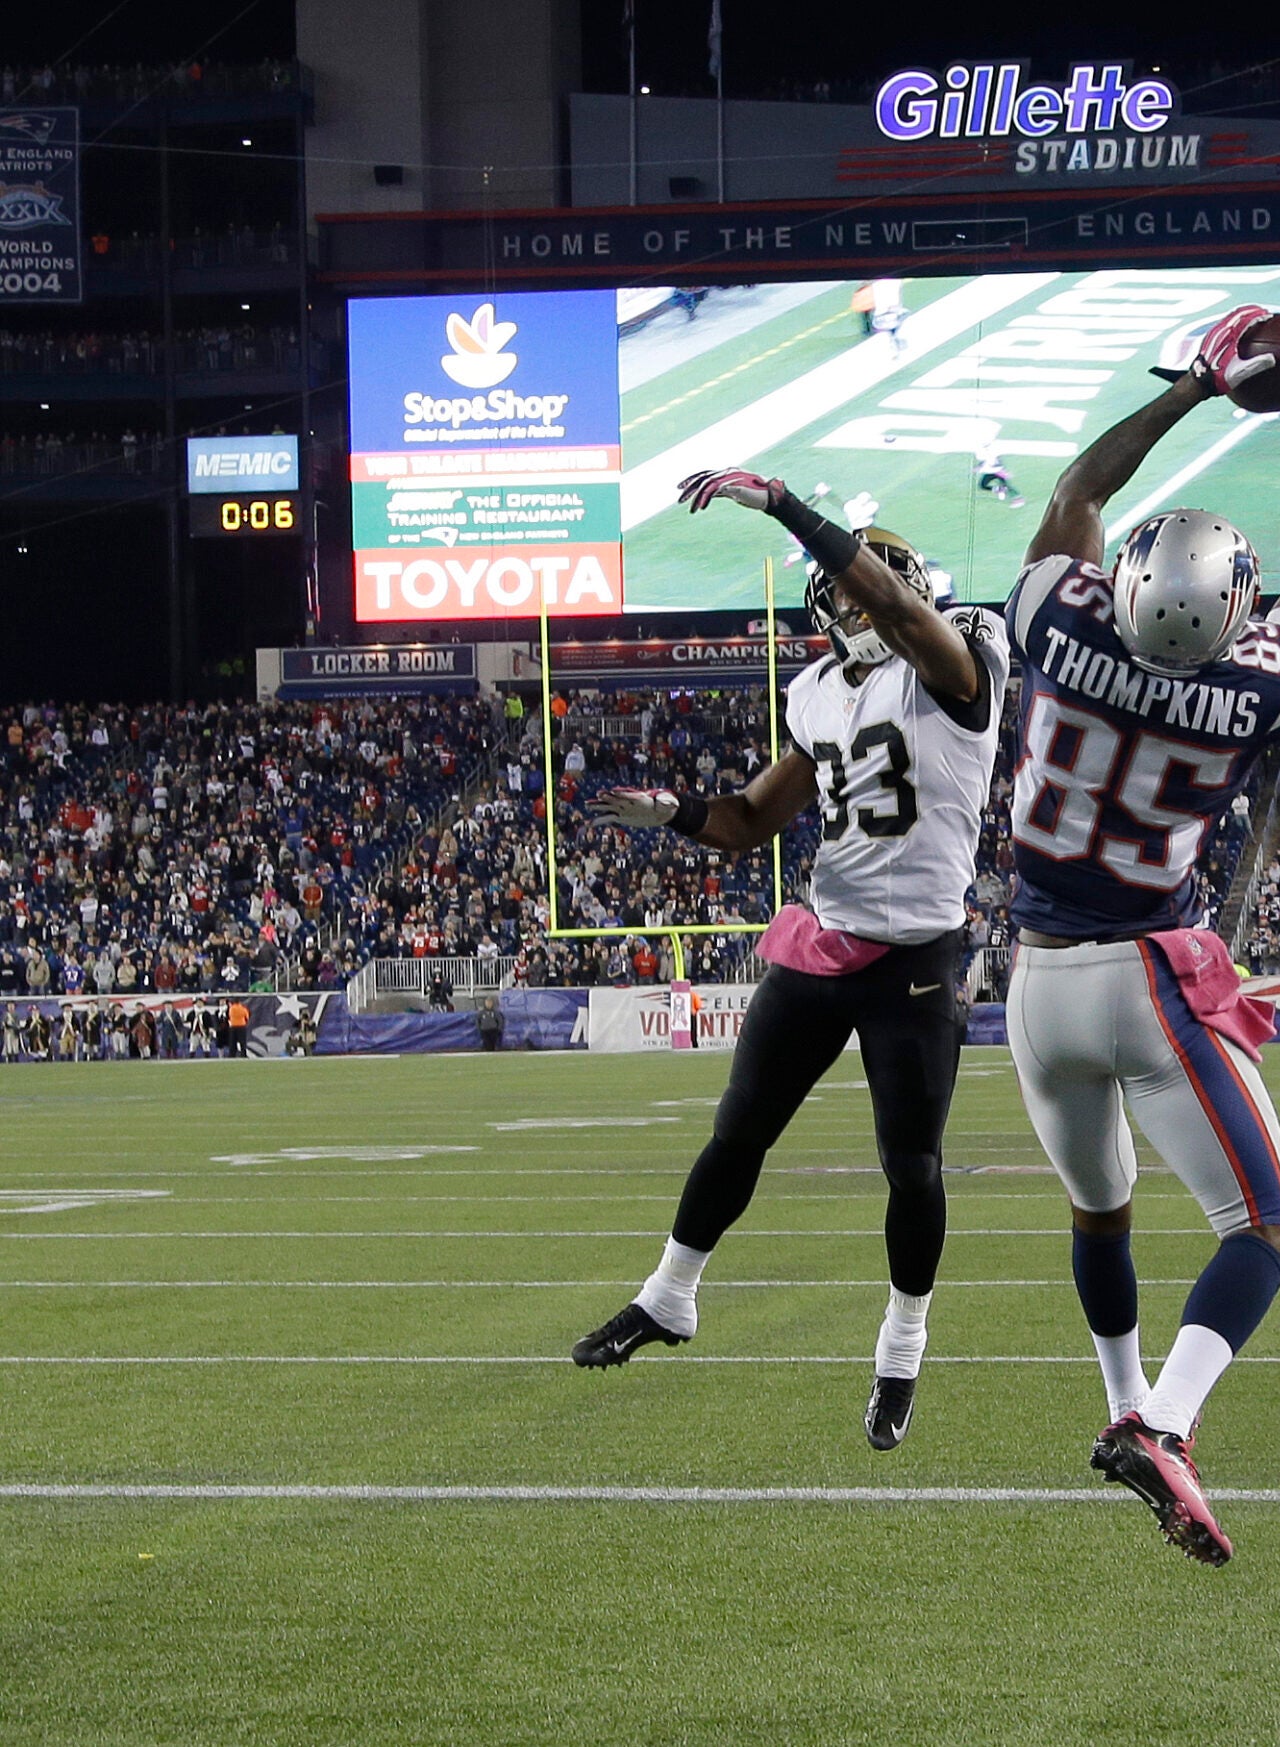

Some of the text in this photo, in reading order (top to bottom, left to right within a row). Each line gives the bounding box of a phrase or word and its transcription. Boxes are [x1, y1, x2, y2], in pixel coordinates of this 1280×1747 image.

[876, 64, 1173, 140] Gillette
[8, 148, 73, 160] ENGLAND
[1015, 133, 1201, 172] STADIUM
[504, 232, 611, 257] HOME
[643, 229, 690, 252] OF
[720, 226, 793, 250] THE
[825, 222, 909, 246] NEW
[1077, 208, 1272, 238] ENGLAND
[404, 390, 567, 428] Stop&Shop
[195, 451, 292, 476] MEMIC
[222, 501, 294, 530] 0:06
[466, 496, 500, 508] THE
[387, 508, 585, 527] TRAINING RESTAURANT
[363, 556, 614, 609] TOYOTA
[312, 650, 455, 674] LOCKER ROOM
[672, 642, 807, 661] CHAMPIONS
[1042, 627, 1260, 739] THOMPKINS
[1013, 692, 1241, 891] 85
[639, 1011, 747, 1037] VONTE
